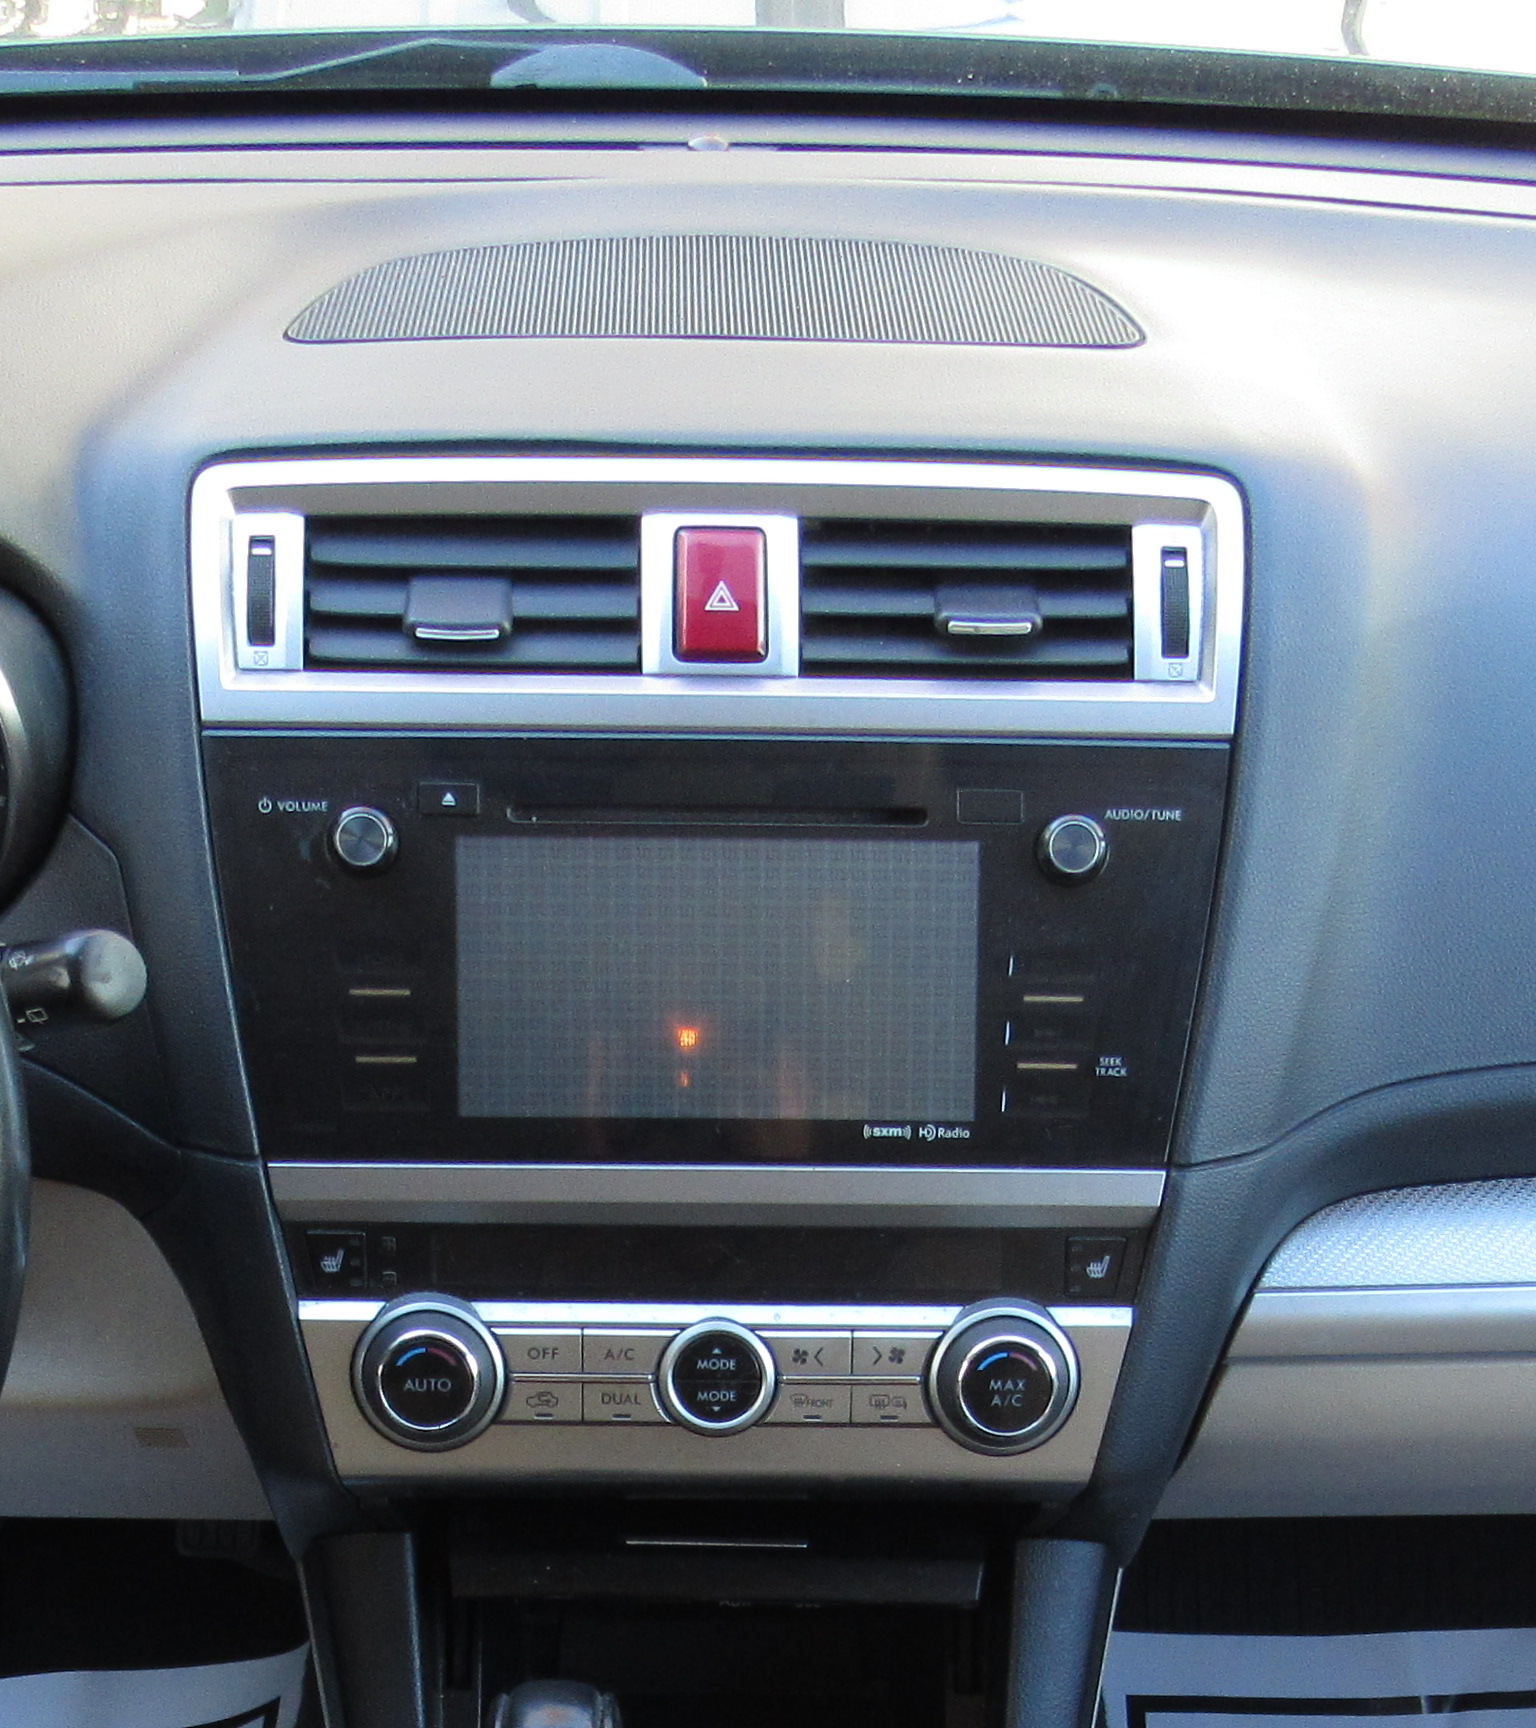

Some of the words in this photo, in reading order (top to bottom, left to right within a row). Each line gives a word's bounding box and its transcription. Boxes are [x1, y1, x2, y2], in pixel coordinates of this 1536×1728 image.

[277, 800, 329, 813] VOLUME
[1104, 808, 1182, 822] AUDIO/TUNE
[1099, 1056, 1123, 1067] SEEK
[1095, 1066, 1128, 1078] TRACK
[937, 1127, 971, 1139] Radio
[527, 1347, 560, 1361] OFF
[604, 1348, 635, 1362] A/C
[696, 1358, 737, 1372] MODE
[402, 1378, 453, 1393] AUTO
[989, 1378, 1027, 1392] MAX
[600, 1392, 642, 1406] DUAL
[697, 1390, 737, 1403] MODE
[807, 1398, 833, 1409] FRONT
[990, 1394, 1024, 1408] A/C
